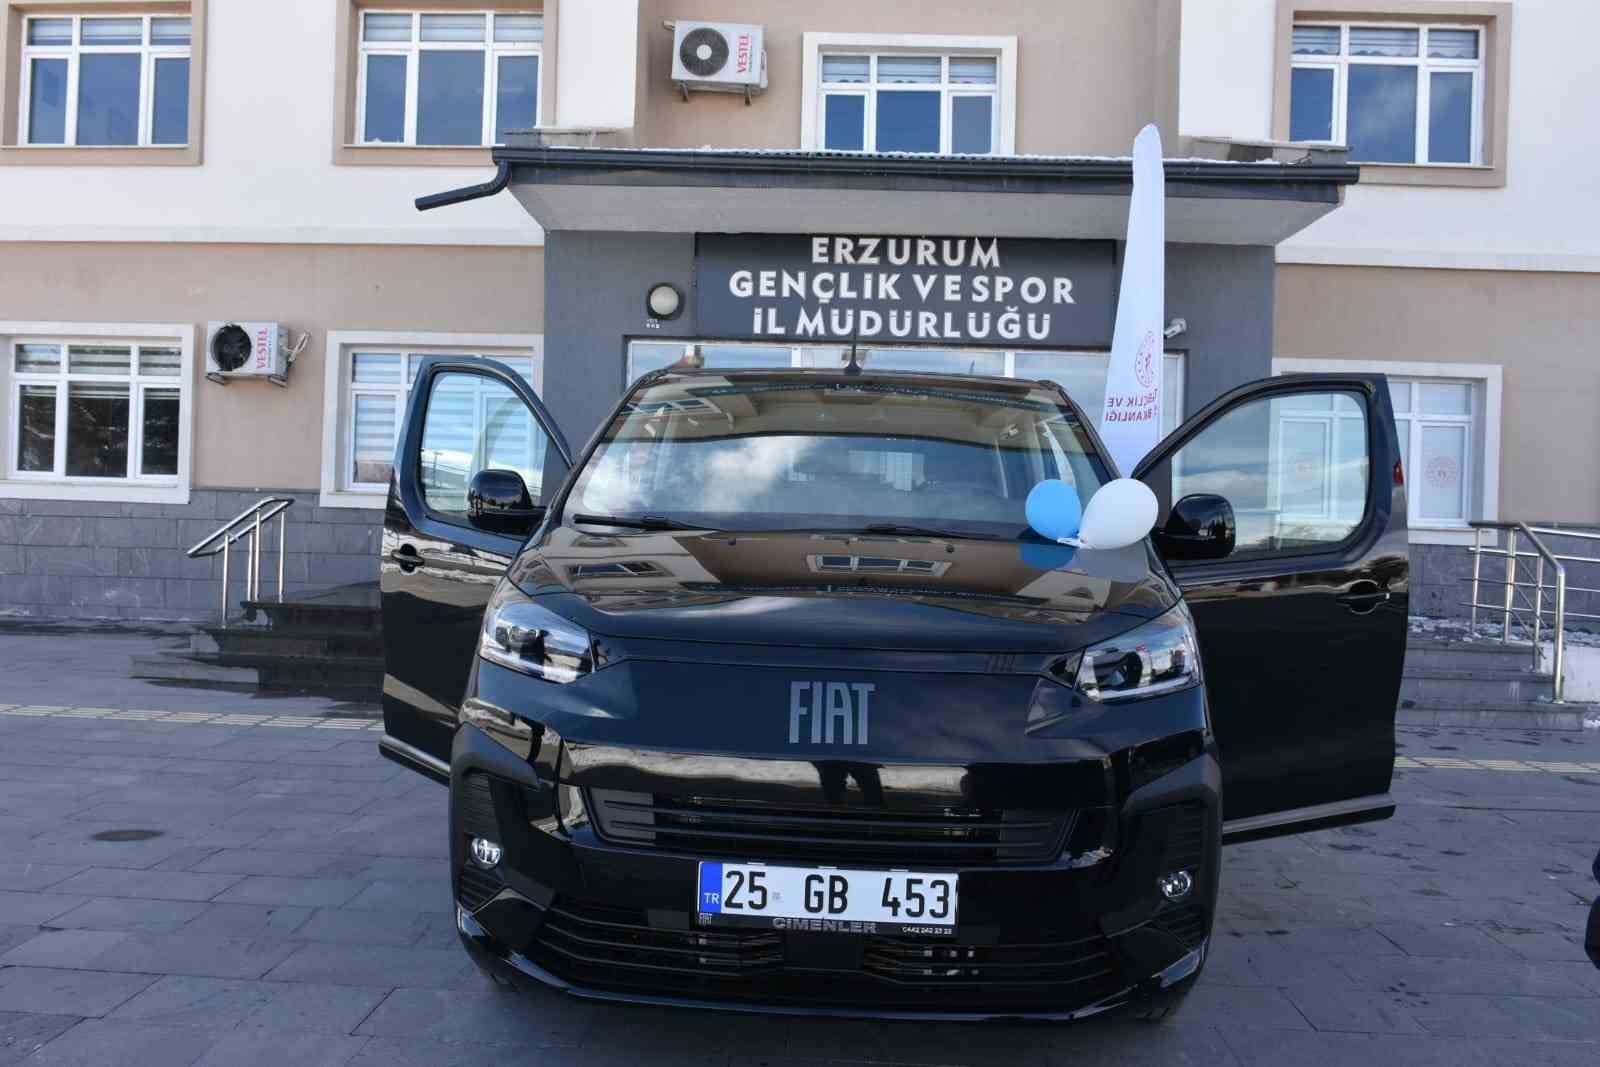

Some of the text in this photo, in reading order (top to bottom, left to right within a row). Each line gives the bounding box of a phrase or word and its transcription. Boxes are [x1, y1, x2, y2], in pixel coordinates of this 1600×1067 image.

[737, 33, 749, 73] VESTEL
[812, 237, 1000, 270] ERZURUM
[729, 269, 1077, 304] GENÇLİK VE SPOR
[753, 306, 1050, 340] İL MÜDÜRLÜĞÜ
[256, 327, 268, 369] VESTEL
[789, 681, 876, 745] FIAT
[703, 892, 720, 904] TR
[724, 870, 950, 919] 25 GB 453
